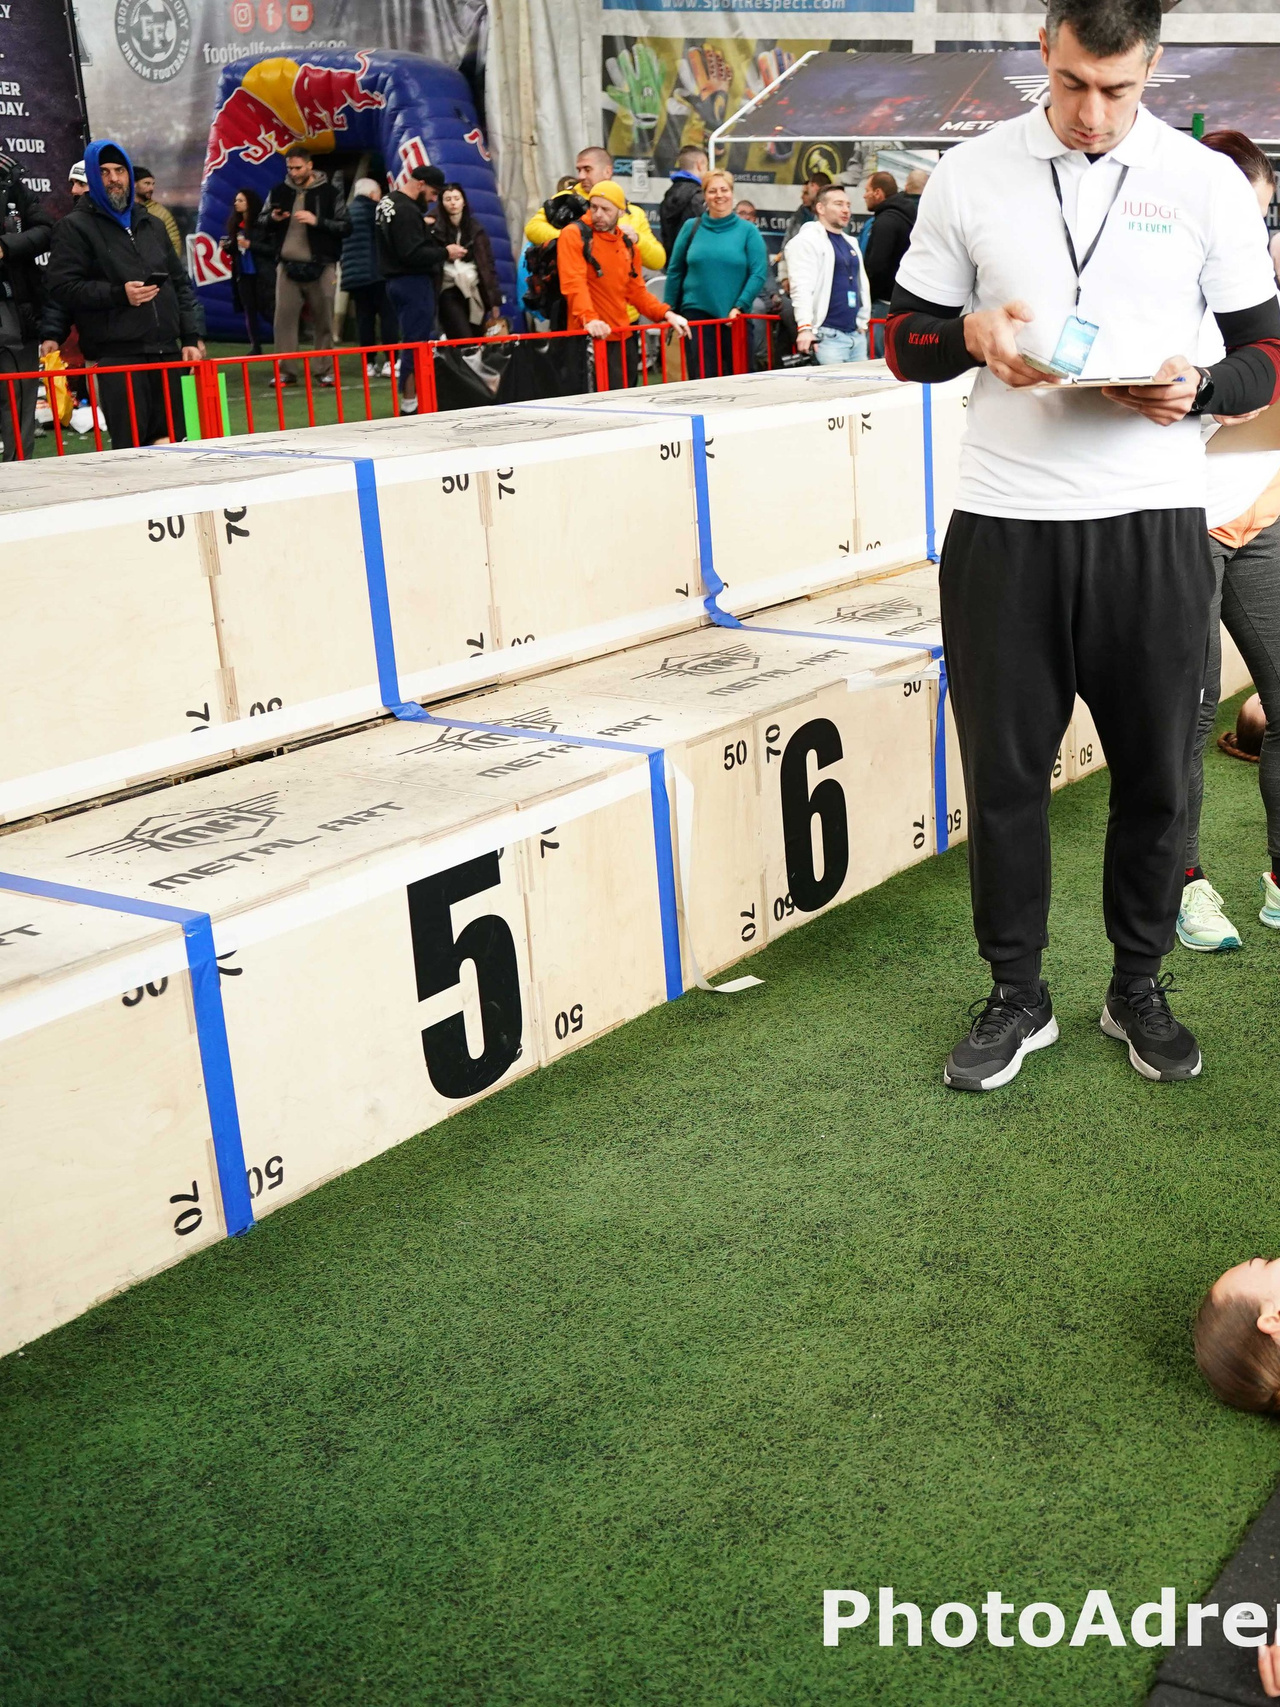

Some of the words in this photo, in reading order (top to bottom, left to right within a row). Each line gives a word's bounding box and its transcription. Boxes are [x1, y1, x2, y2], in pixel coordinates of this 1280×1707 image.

[120, 40, 151, 79] DREAM
[5, 137, 46, 153] YOUR
[939, 120, 1001, 132] META
[1120, 200, 1183, 221] JUDGE
[1145, 222, 1173, 234] EVENT
[147, 514, 186, 542] 50
[706, 665, 803, 697] METAL
[797, 648, 850, 667] ART
[476, 743, 584, 779] META
[597, 714, 664, 738] ART
[723, 739, 748, 772] 50
[765, 723, 782, 764] 70
[1079, 743, 1093, 767] 50
[779, 717, 850, 913] 6
[912, 814, 926, 850] 70
[148, 835, 322, 891] METAL
[317, 801, 405, 832] ART
[740, 902, 757, 943] 70
[406, 850, 523, 1100] 5
[554, 1003, 584, 1042] 50
[169, 1180, 202, 1237] 70
